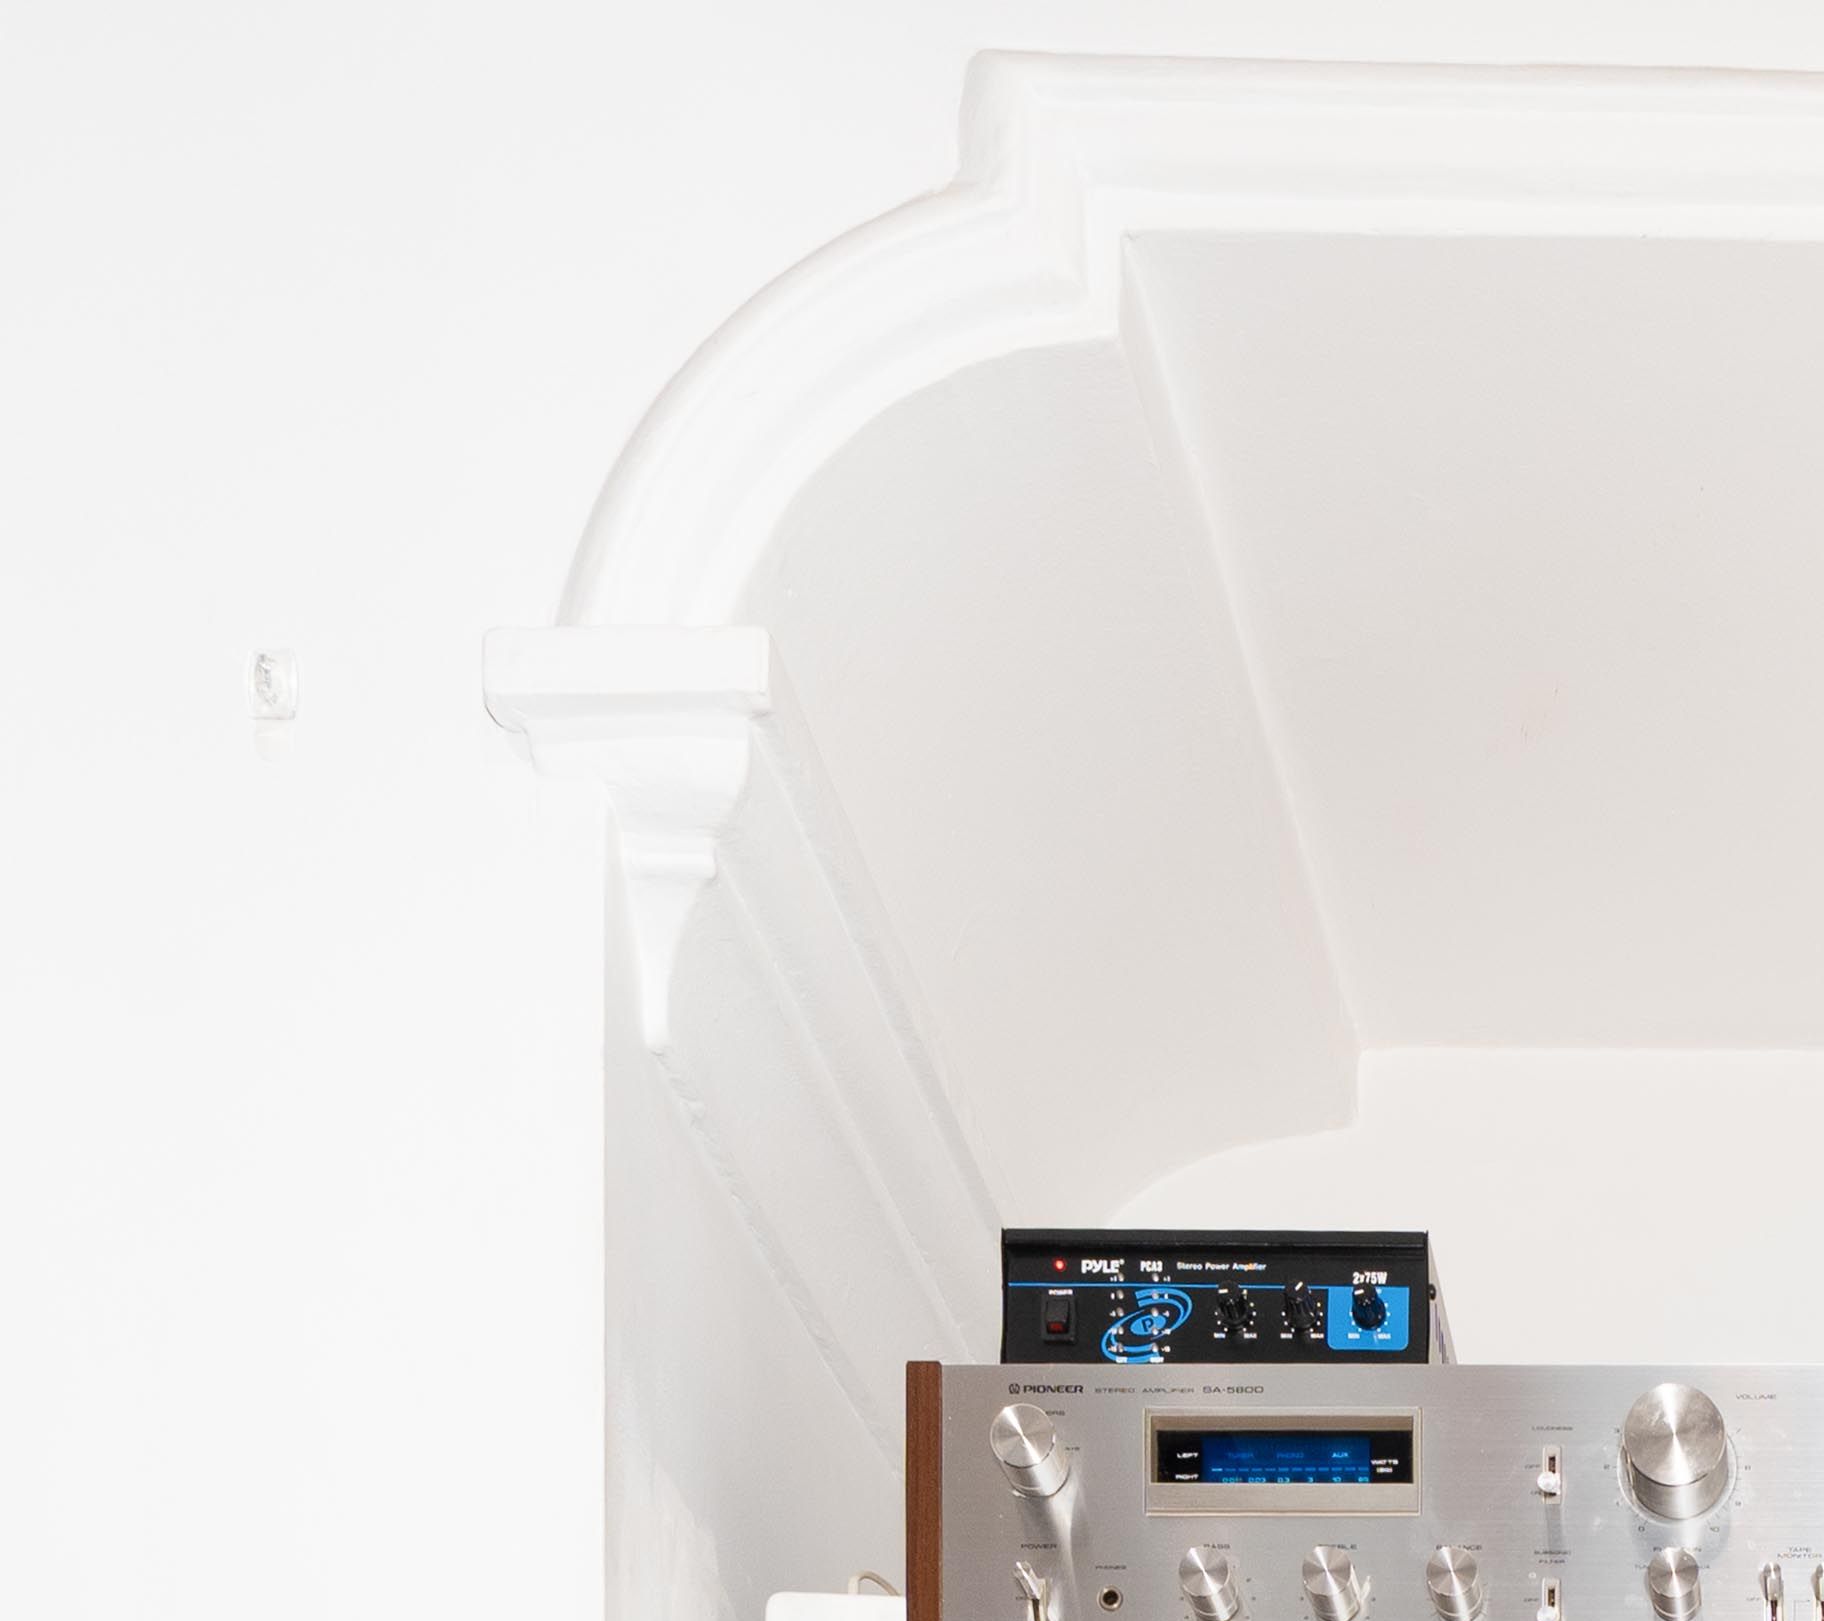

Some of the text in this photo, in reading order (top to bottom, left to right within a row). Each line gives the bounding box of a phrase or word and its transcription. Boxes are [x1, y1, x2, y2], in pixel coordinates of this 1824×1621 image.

[1081, 1259, 1267, 1273] PYLE PCA3 Stereo Power Amplifier
[1353, 1271, 1388, 1285] 2x75W
[1023, 1384, 1084, 1394] PIONEER
